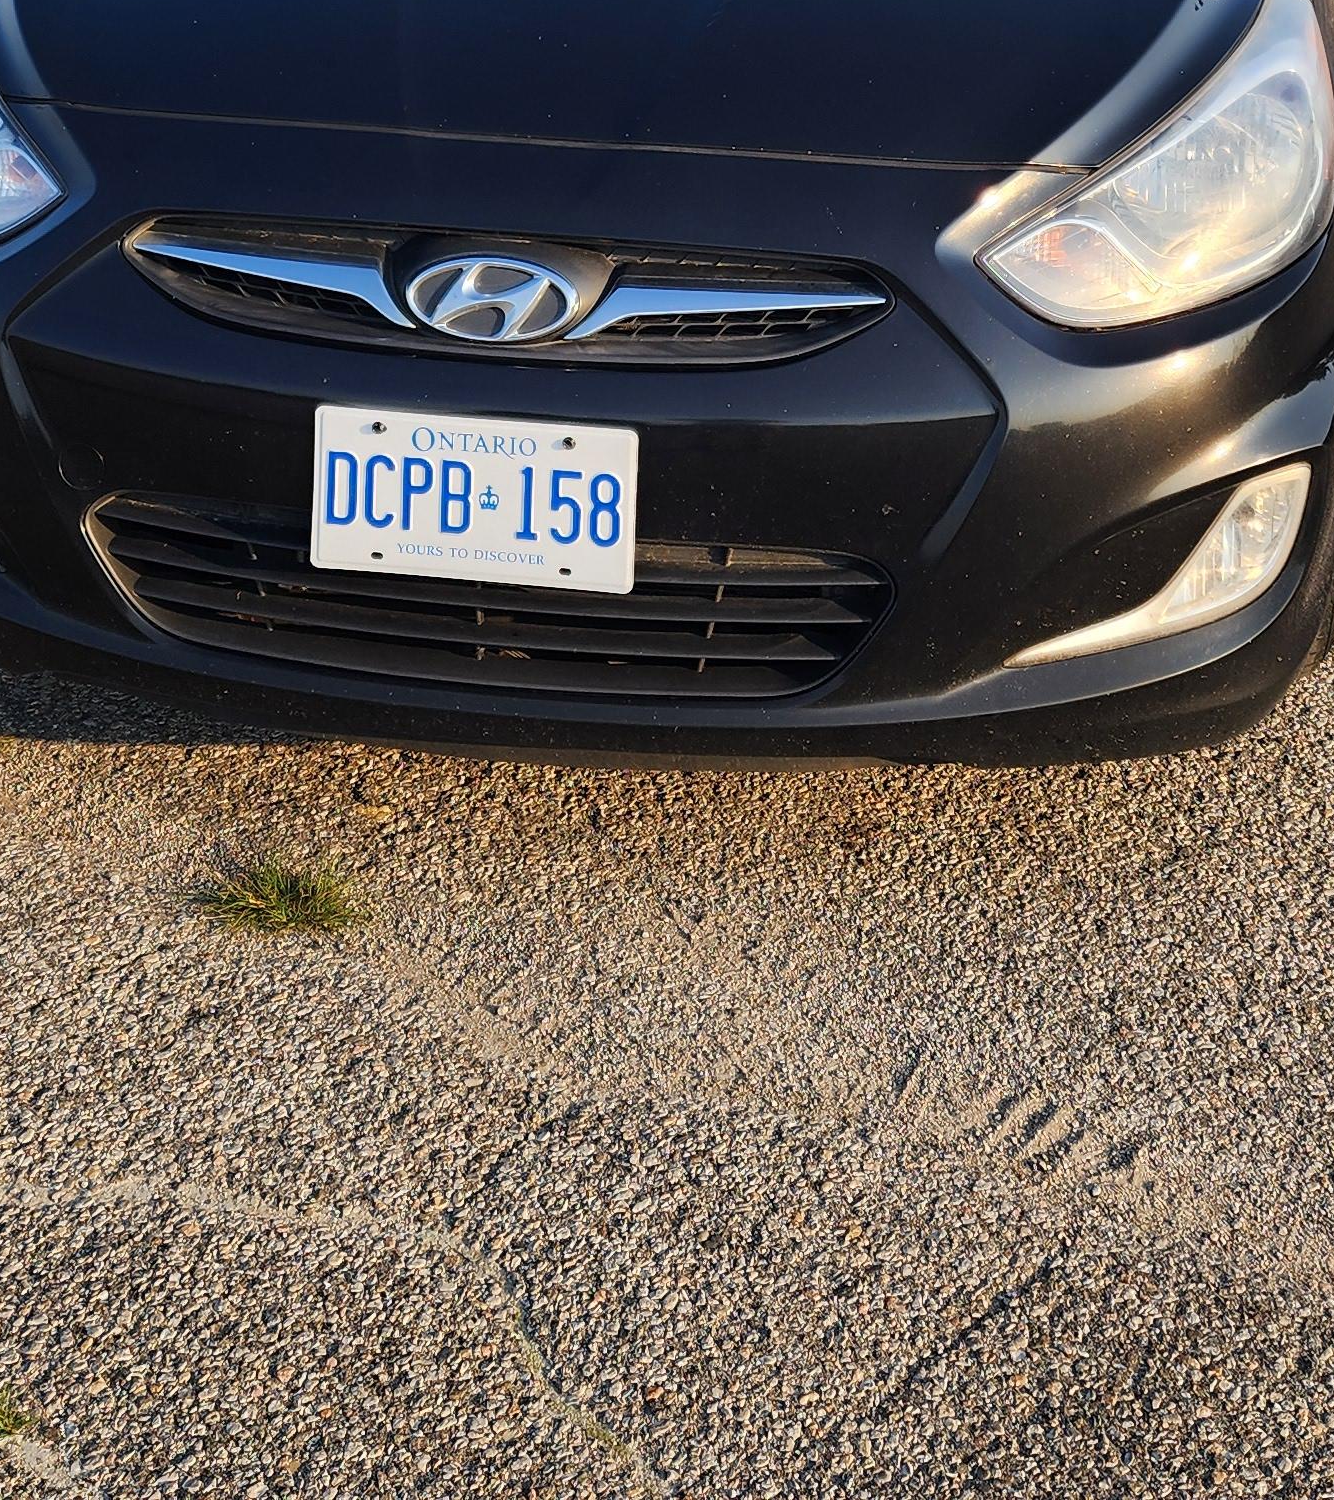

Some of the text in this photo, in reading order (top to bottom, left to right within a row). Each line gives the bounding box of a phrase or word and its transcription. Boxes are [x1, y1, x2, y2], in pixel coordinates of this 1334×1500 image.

[411, 426, 537, 459] ONTARIO
[326, 451, 621, 547] DCPB 158
[397, 542, 544, 566] YOURS TO DISCOVER
